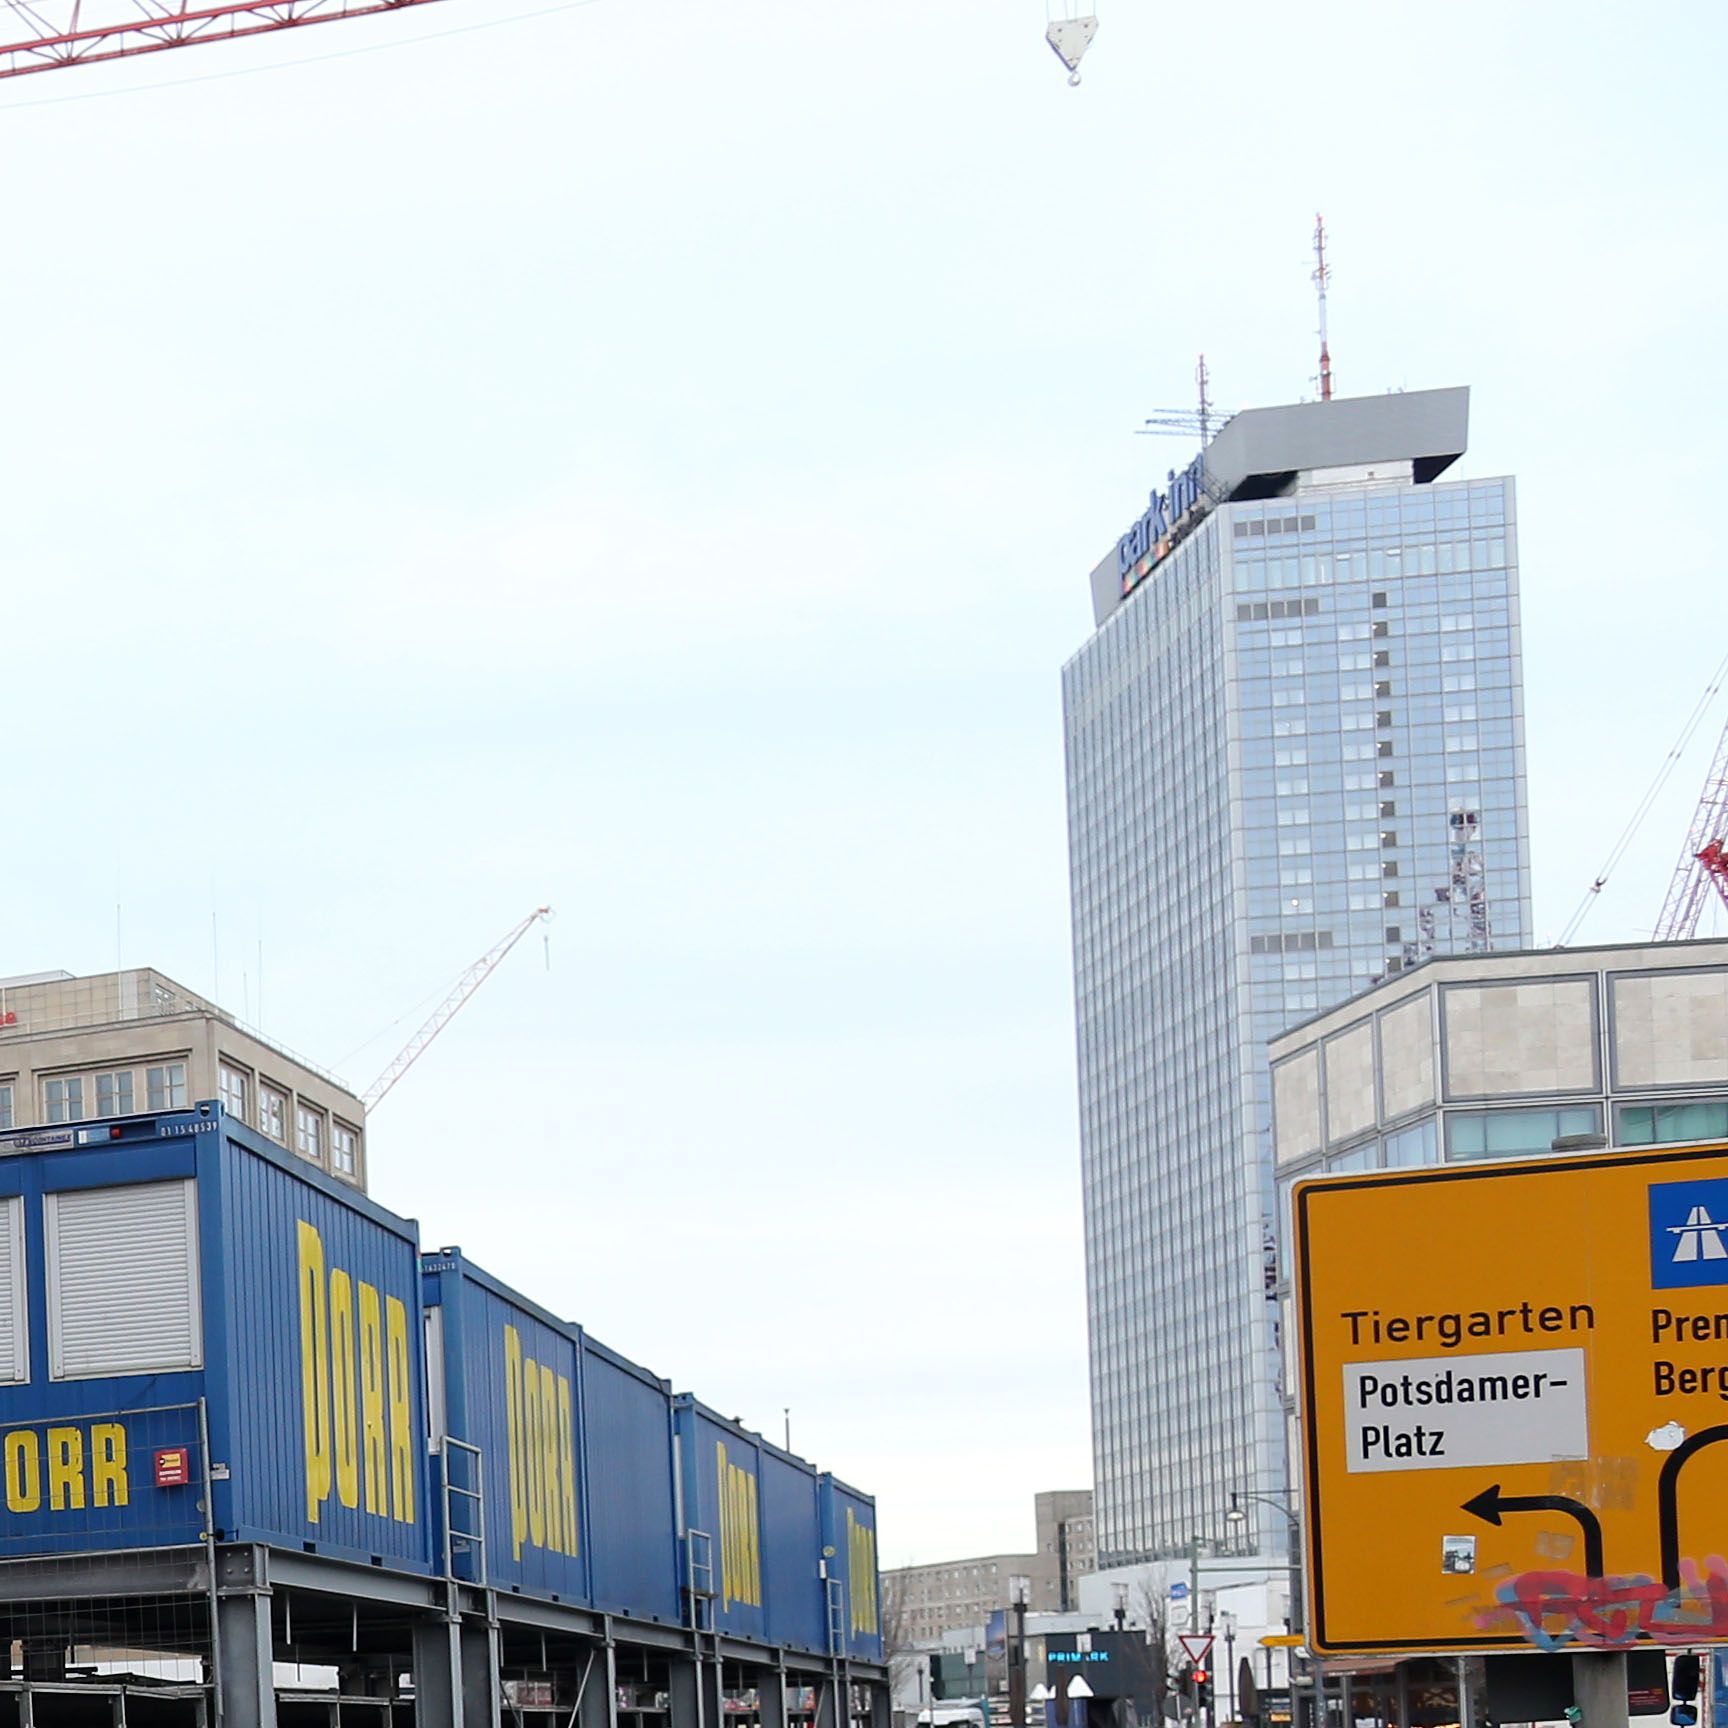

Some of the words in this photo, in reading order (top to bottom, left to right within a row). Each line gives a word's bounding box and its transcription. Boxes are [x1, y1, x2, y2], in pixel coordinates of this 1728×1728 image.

[1340, 1301, 1596, 1349] Tiergarten
[296, 1218, 416, 1525] PORR
[1359, 1369, 1569, 1409] Potsdamer-
[503, 1323, 578, 1563] PORR
[1361, 1425, 1446, 1460] Platz
[1047, 1650, 1110, 1662] PRIMRK
